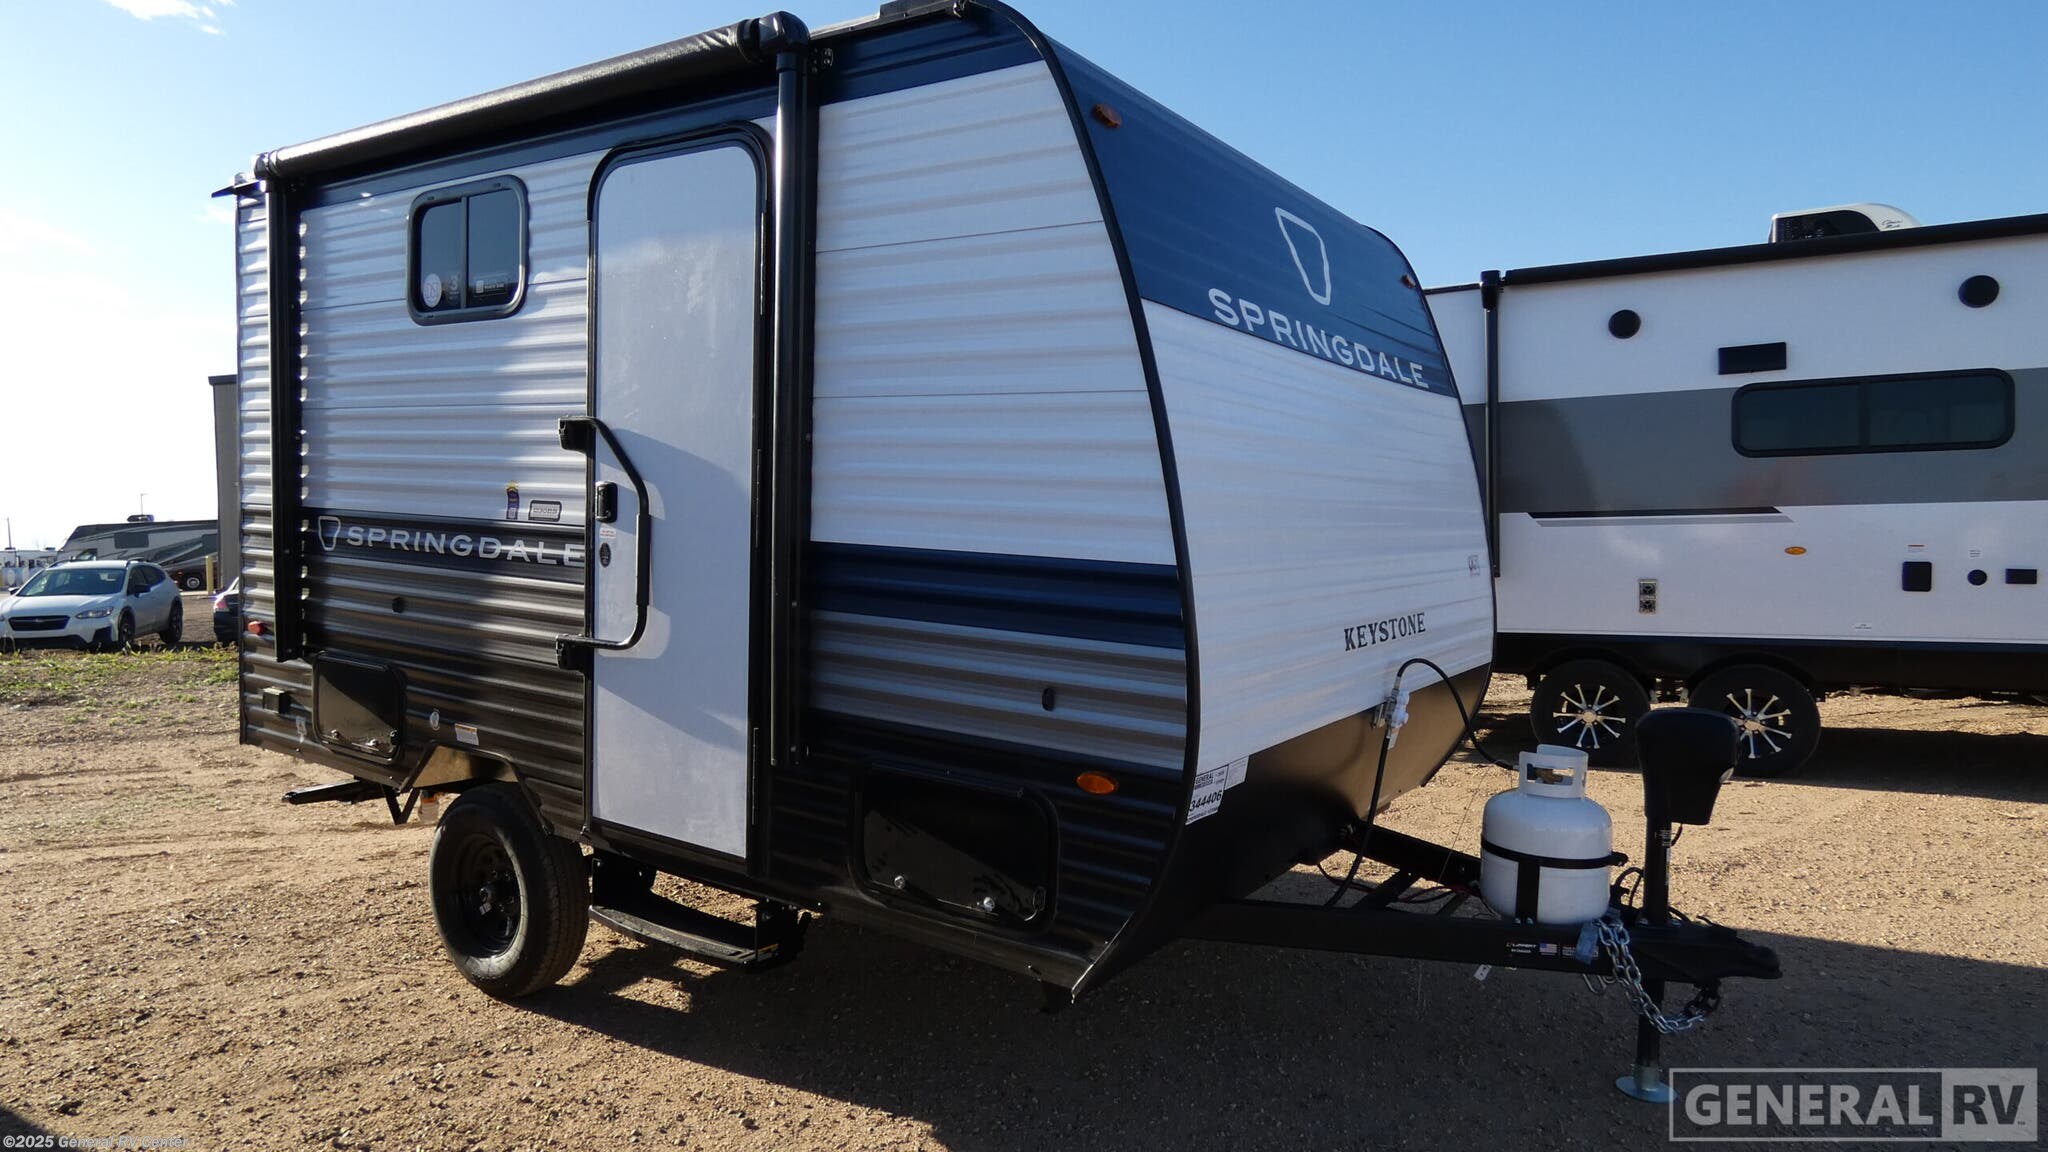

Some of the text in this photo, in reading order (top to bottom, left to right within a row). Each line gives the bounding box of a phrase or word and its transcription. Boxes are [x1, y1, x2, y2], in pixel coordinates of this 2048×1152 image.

[1208, 288, 1429, 388] SPRINGDALE
[346, 525, 585, 567] SPRINGDALE
[1344, 612, 1426, 651] KEYSTONE
[1190, 790, 1223, 812] 344406
